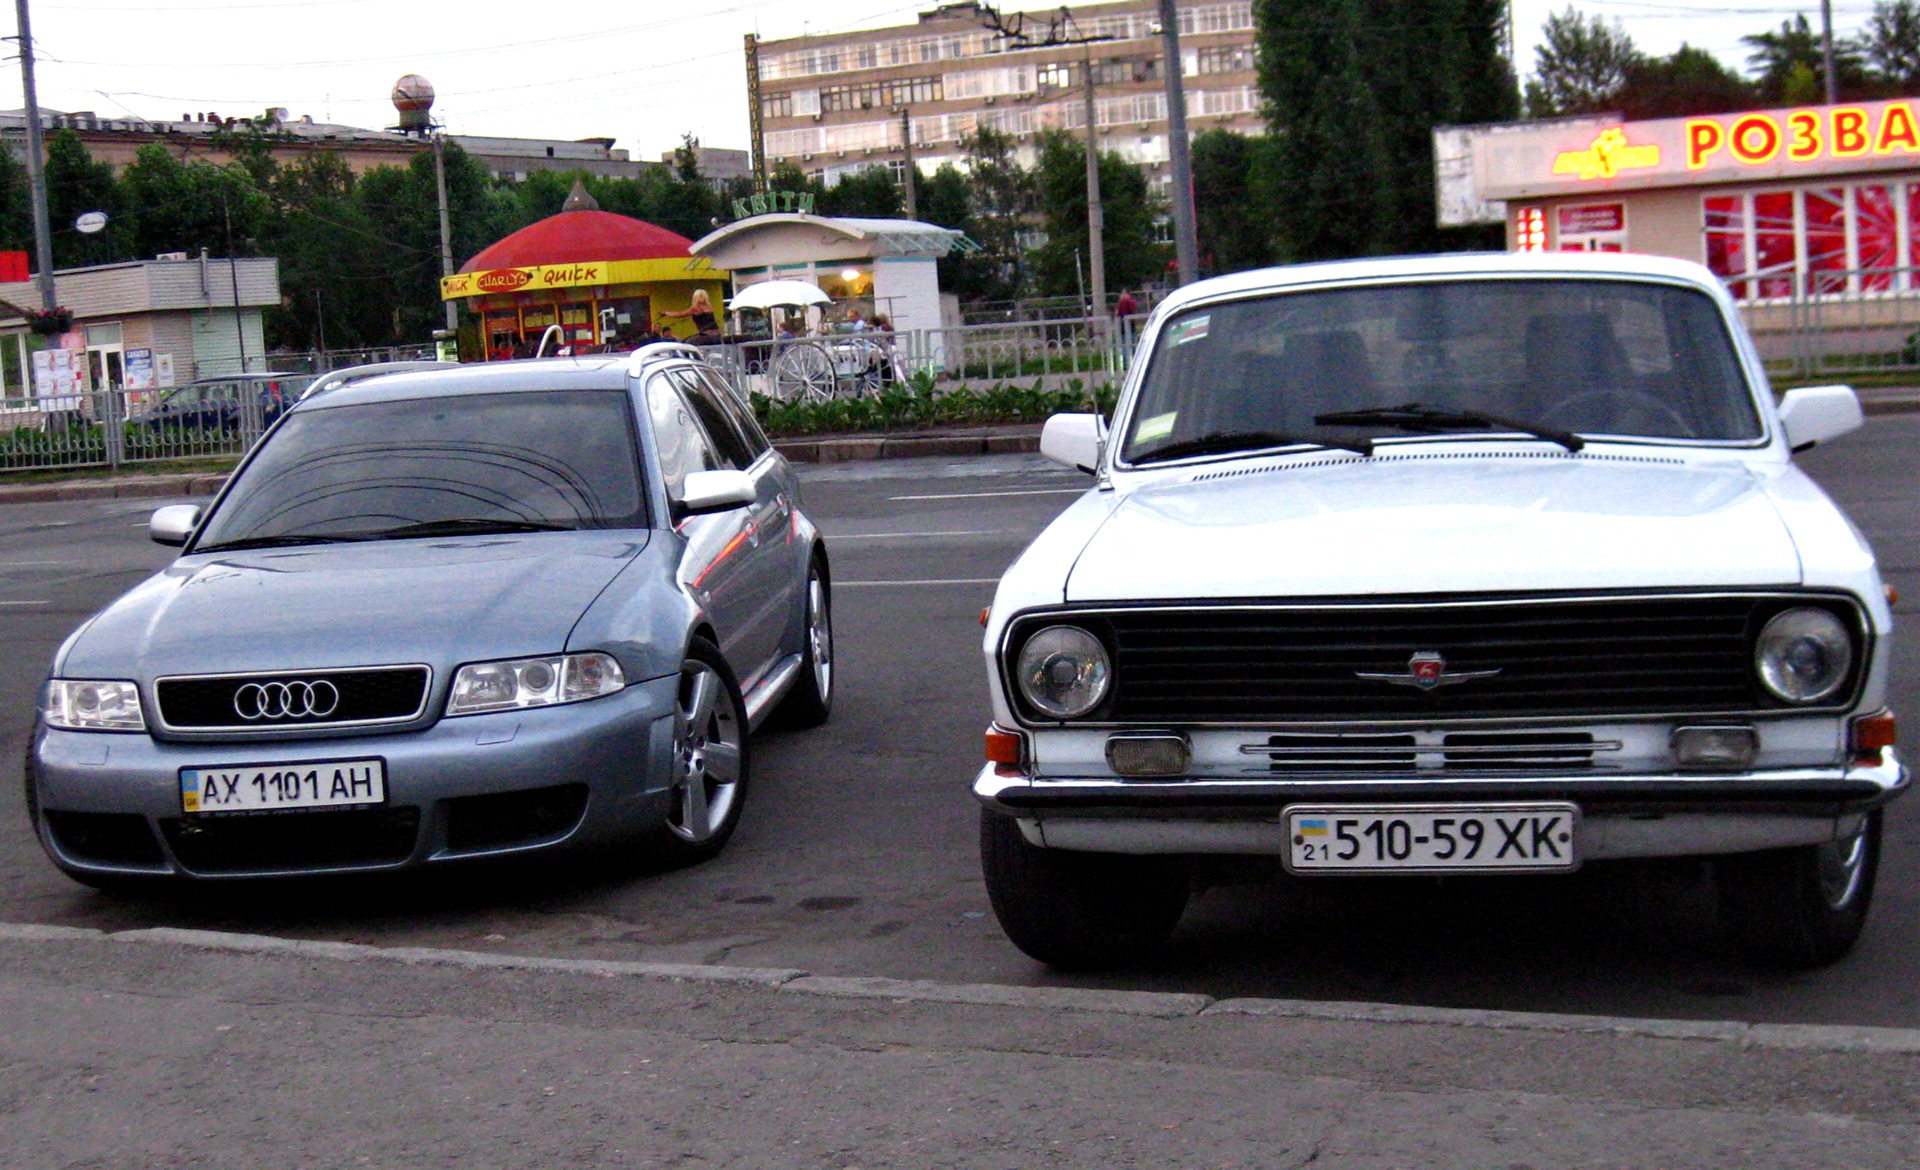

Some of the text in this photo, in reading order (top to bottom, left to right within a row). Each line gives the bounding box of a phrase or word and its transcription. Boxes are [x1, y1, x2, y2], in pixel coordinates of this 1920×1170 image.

[731, 191, 815, 219] КВІТИ
[543, 267, 598, 286] QUICK
[202, 766, 373, 804] AX 1101 AH
[1303, 844, 1329, 861] 21
[1336, 816, 1562, 861] 510-59 XK
